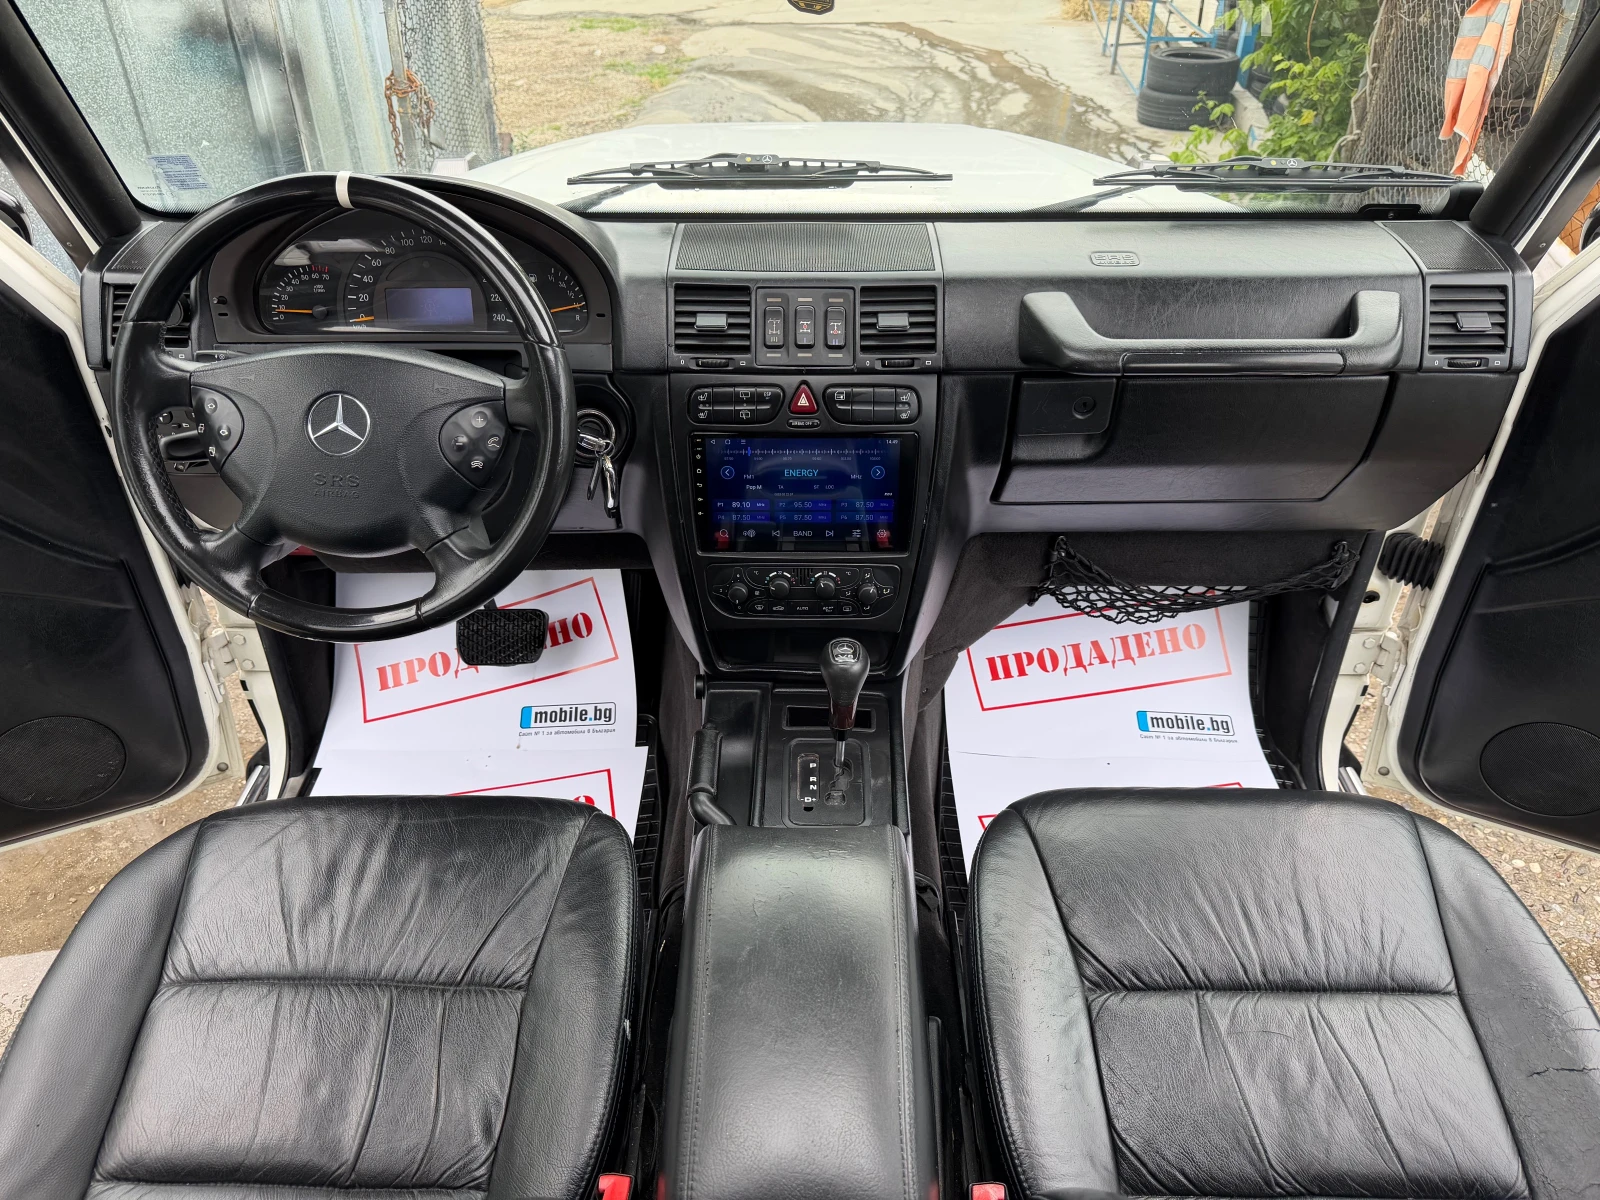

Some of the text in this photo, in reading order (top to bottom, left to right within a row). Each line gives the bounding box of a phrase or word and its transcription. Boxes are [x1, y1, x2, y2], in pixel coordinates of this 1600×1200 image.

[400, 238, 414, 246] 100
[420, 236, 433, 244] 120
[385, 246, 395, 254] 80
[371, 259, 382, 267] 60
[362, 275, 374, 283] 40
[358, 293, 369, 302] 20
[492, 313, 506, 322] 240
[784, 468, 819, 477] ENERGY
[314, 472, 360, 488] SRS
[731, 501, 751, 509] 89.10
[793, 501, 813, 509] 95.50
[376, 612, 593, 692] ПРОНО
[985, 623, 1207, 681] ПРОДАДЕНО
[533, 705, 613, 724] mobile.bg
[1150, 714, 1231, 734] mobile.bg
